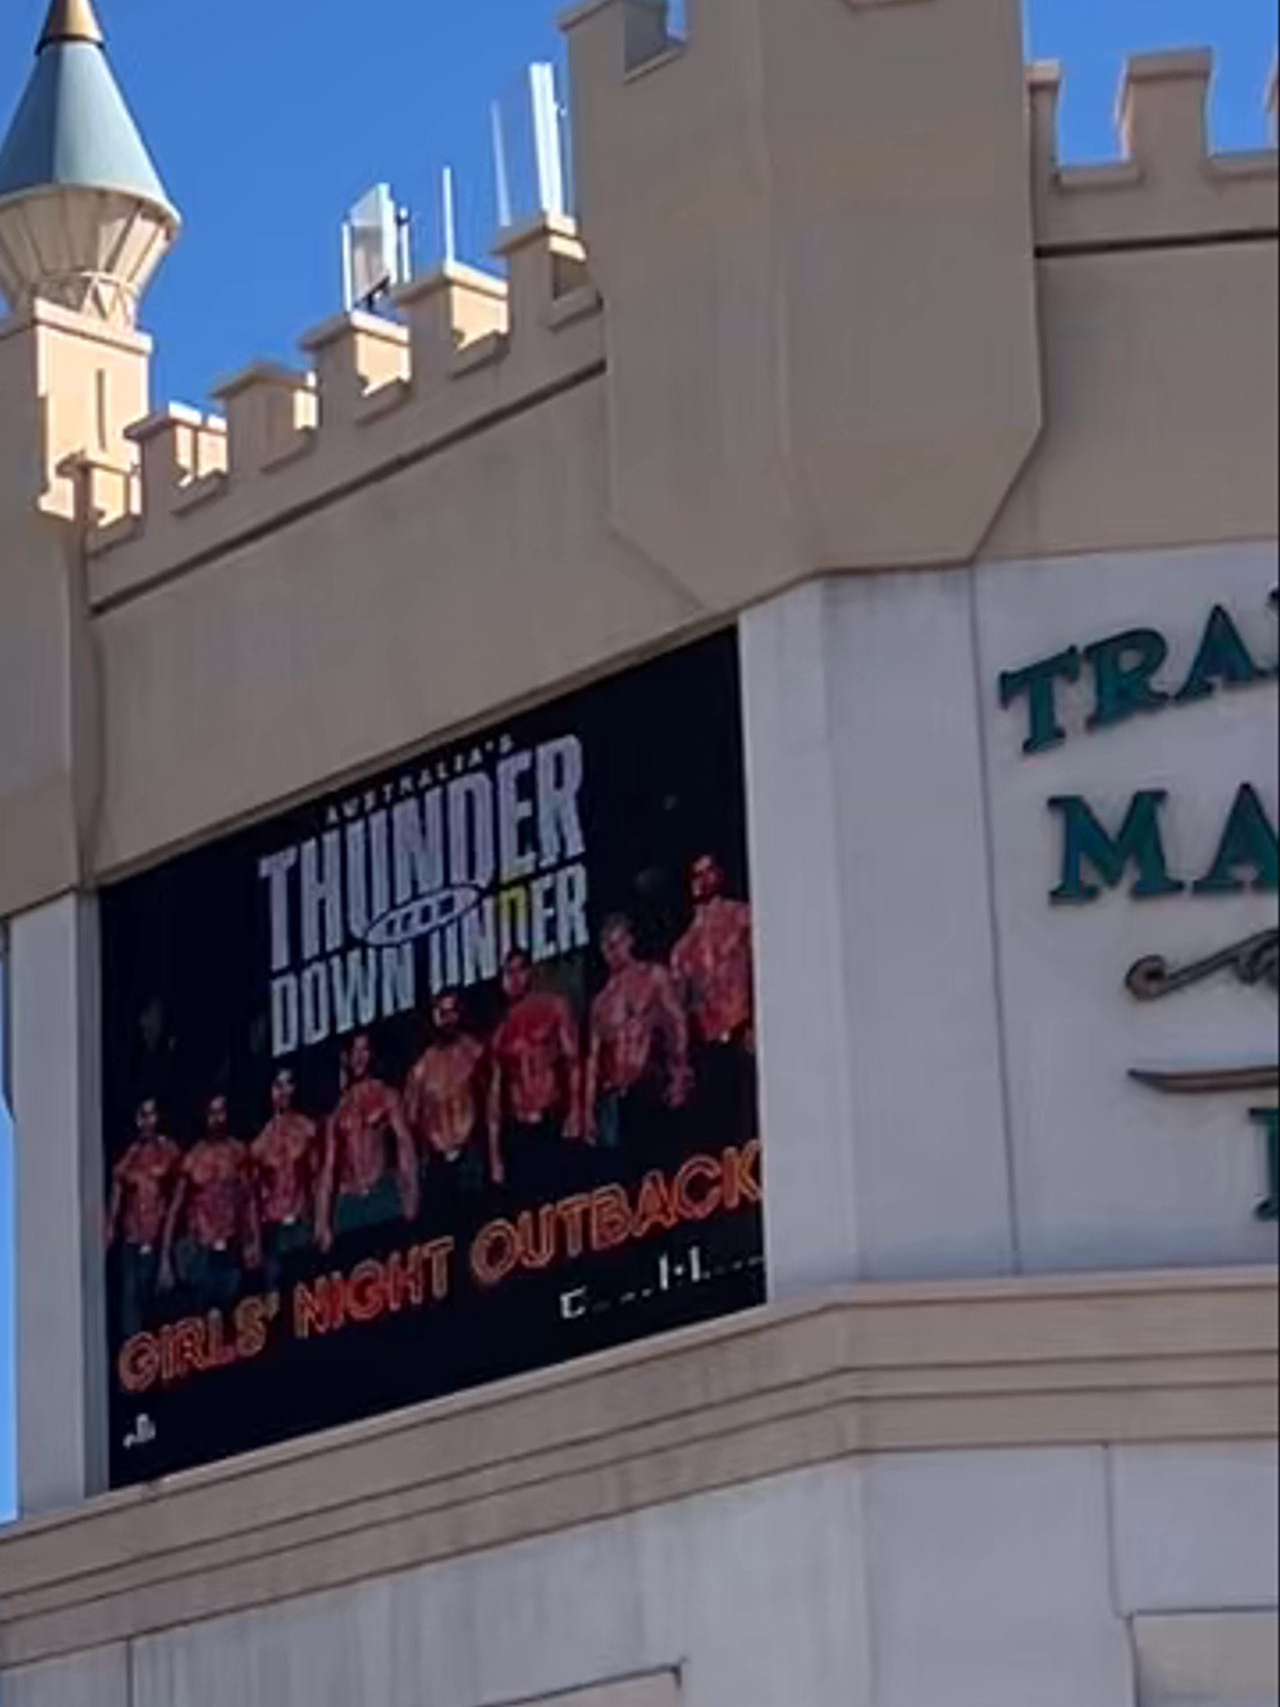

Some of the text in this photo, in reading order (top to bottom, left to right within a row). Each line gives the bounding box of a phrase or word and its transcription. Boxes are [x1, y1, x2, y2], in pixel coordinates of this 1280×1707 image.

[998, 589, 1278, 755] TRA
[258, 733, 586, 971] THUNDER
[271, 862, 590, 1058] DOWN UNDER
[117, 1290, 282, 1392] GIRLS'
[293, 1237, 455, 1339] NIGHT
[470, 1140, 763, 1283] OUTBACK
